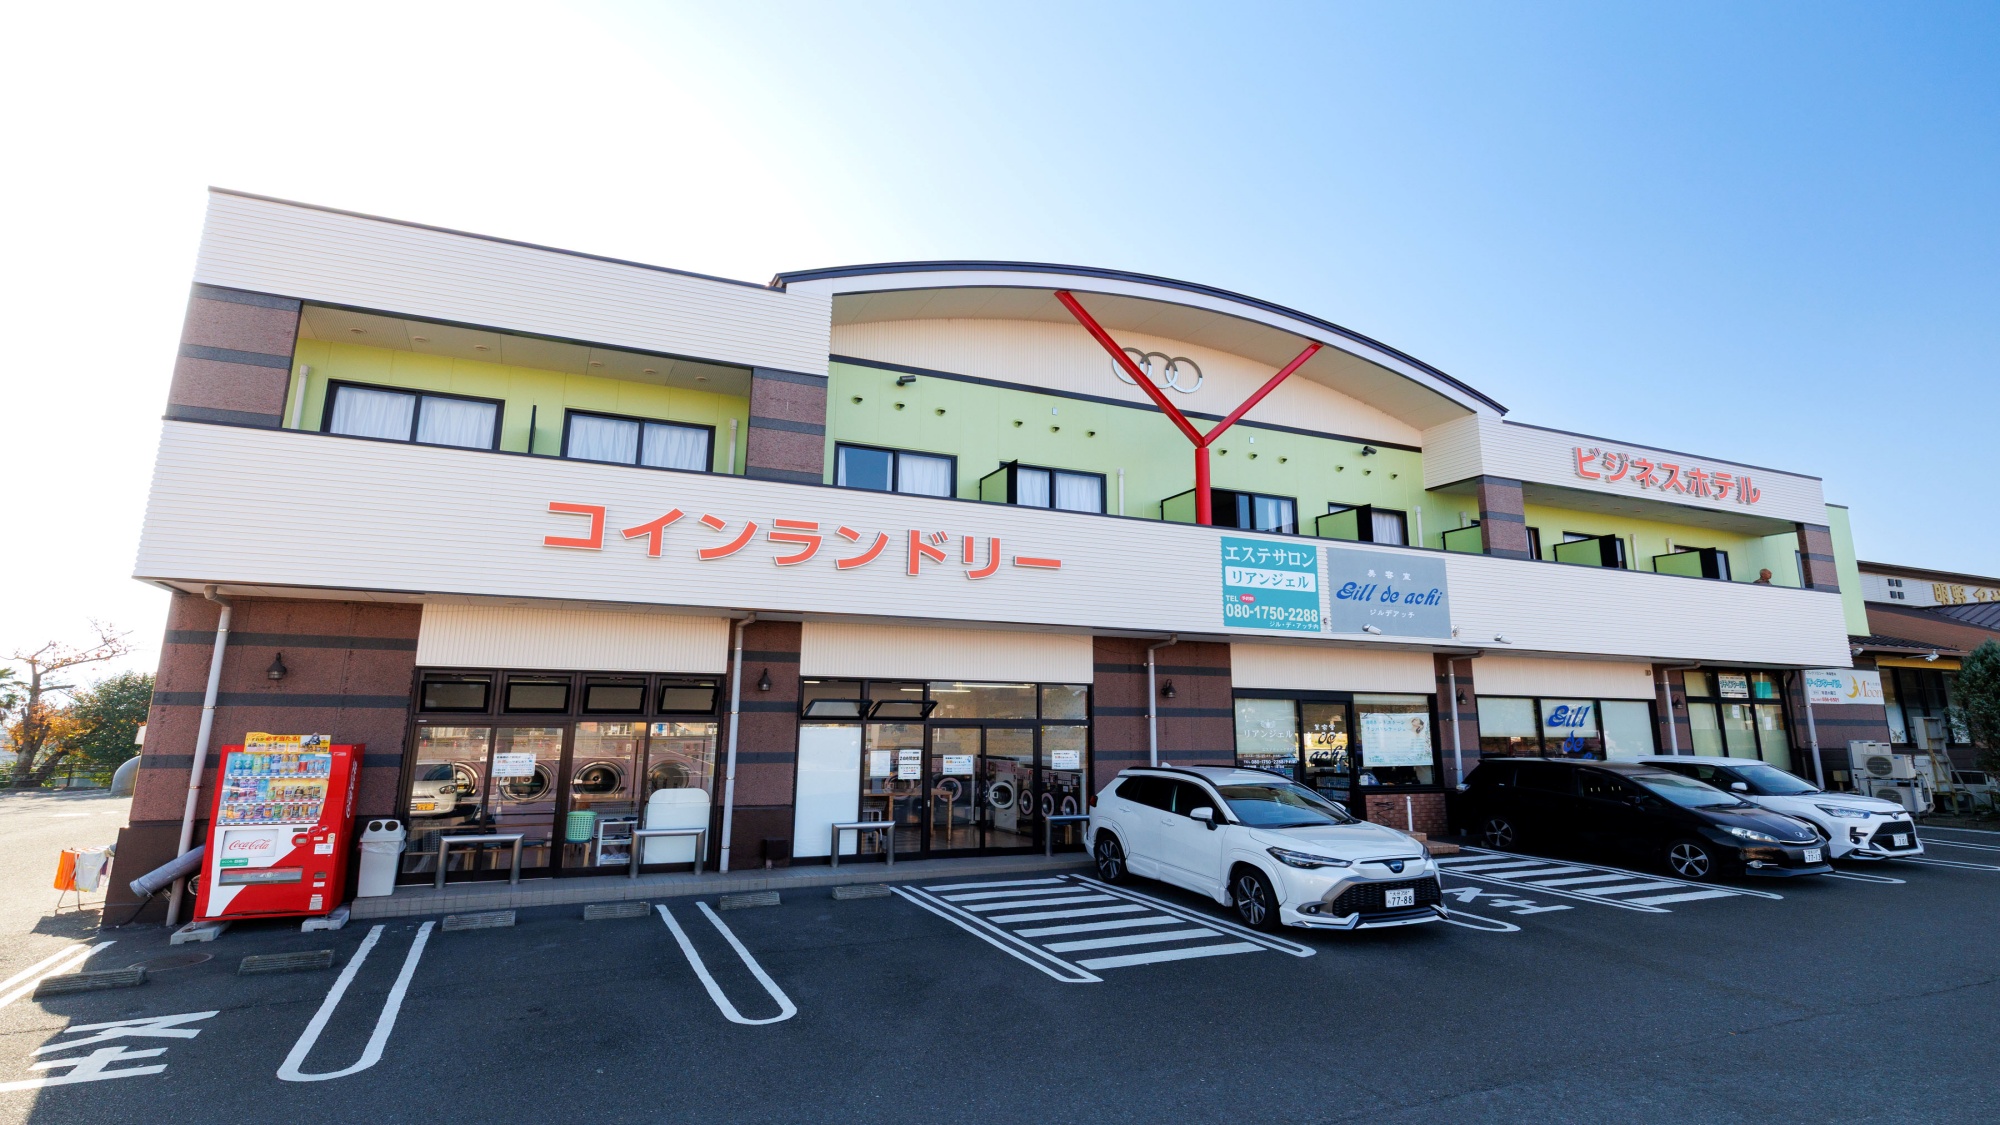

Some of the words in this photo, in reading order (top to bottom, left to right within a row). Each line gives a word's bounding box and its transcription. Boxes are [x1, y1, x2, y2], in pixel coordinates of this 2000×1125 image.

[1572, 446, 1761, 505] ビジネスホテル
[542, 500, 1063, 580] コインランドリー
[1224, 545, 1315, 568] エステサロン
[1231, 570, 1309, 589] リアンジェル
[1367, 569, 1411, 581] 美容室
[1225, 594, 1239, 602] TEL
[1336, 581, 1377, 603] Gill
[1380, 584, 1400, 603] de
[1404, 587, 1443, 606] achi
[1225, 603, 1319, 623] 080-1750-2288
[1370, 609, 1415, 619] ジルデアッチ
[1857, 681, 1883, 698] Moon
[1547, 704, 1591, 728] Gill
[1243, 729, 1294, 739] リアンジェル
[1563, 730, 1585, 753] de
[228, 838, 272, 851] Coca-Cola
[1392, 896, 1412, 905] 77-88
